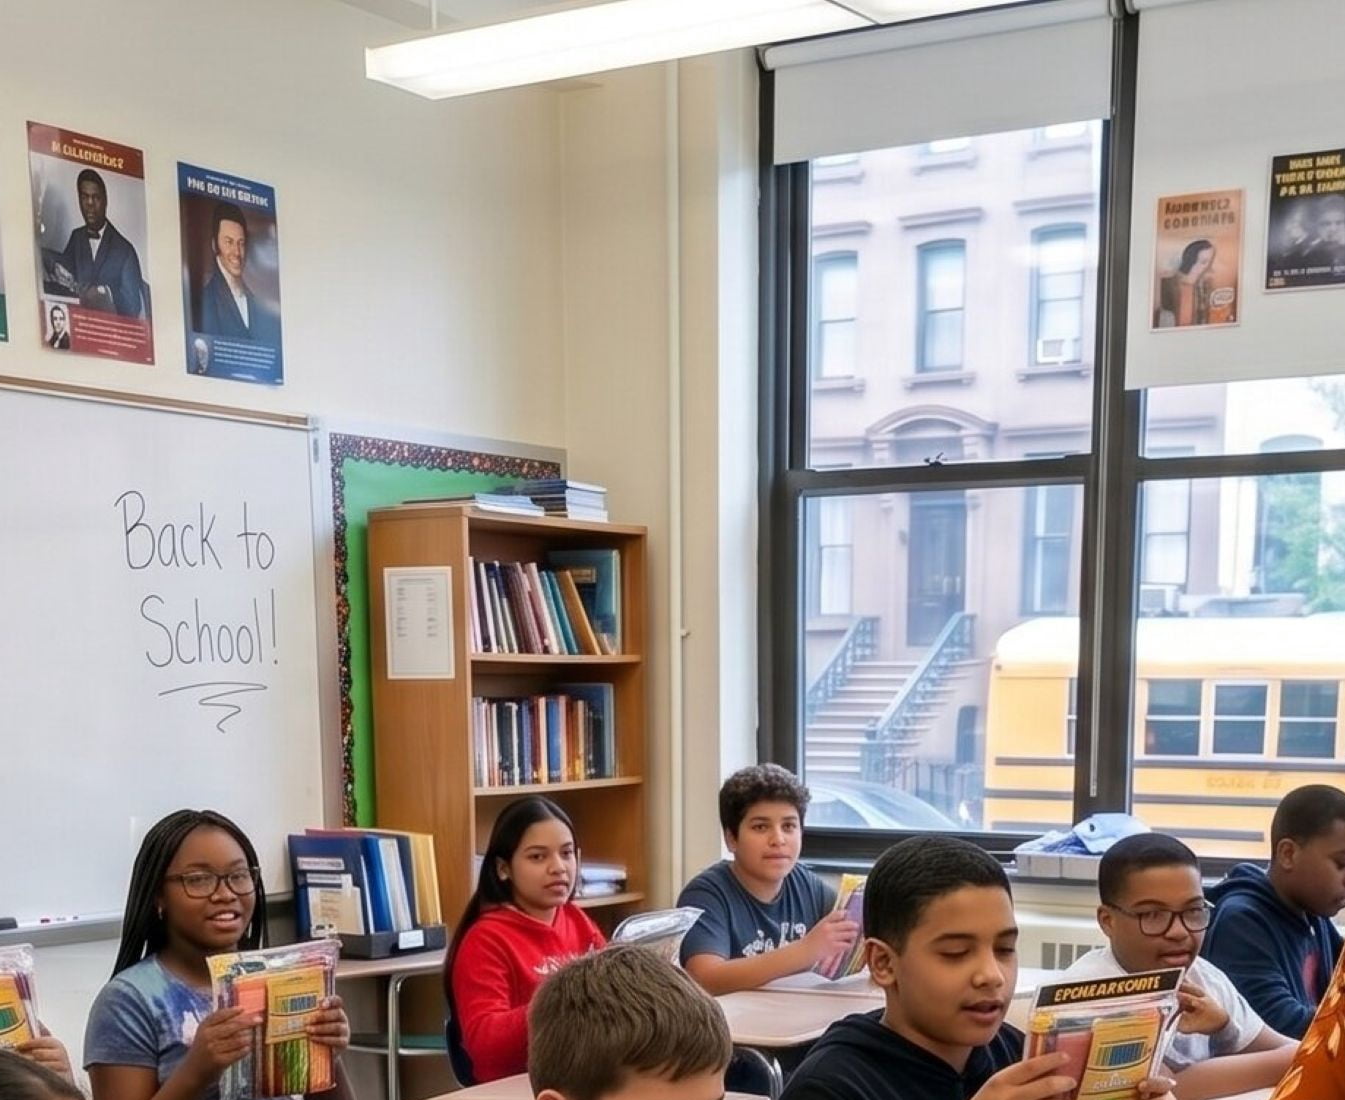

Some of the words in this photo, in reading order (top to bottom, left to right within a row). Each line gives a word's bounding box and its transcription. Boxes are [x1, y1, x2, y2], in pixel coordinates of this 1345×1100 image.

[113, 490, 223, 570] Back
[236, 501, 275, 570] to
[140, 588, 279, 668] School!
